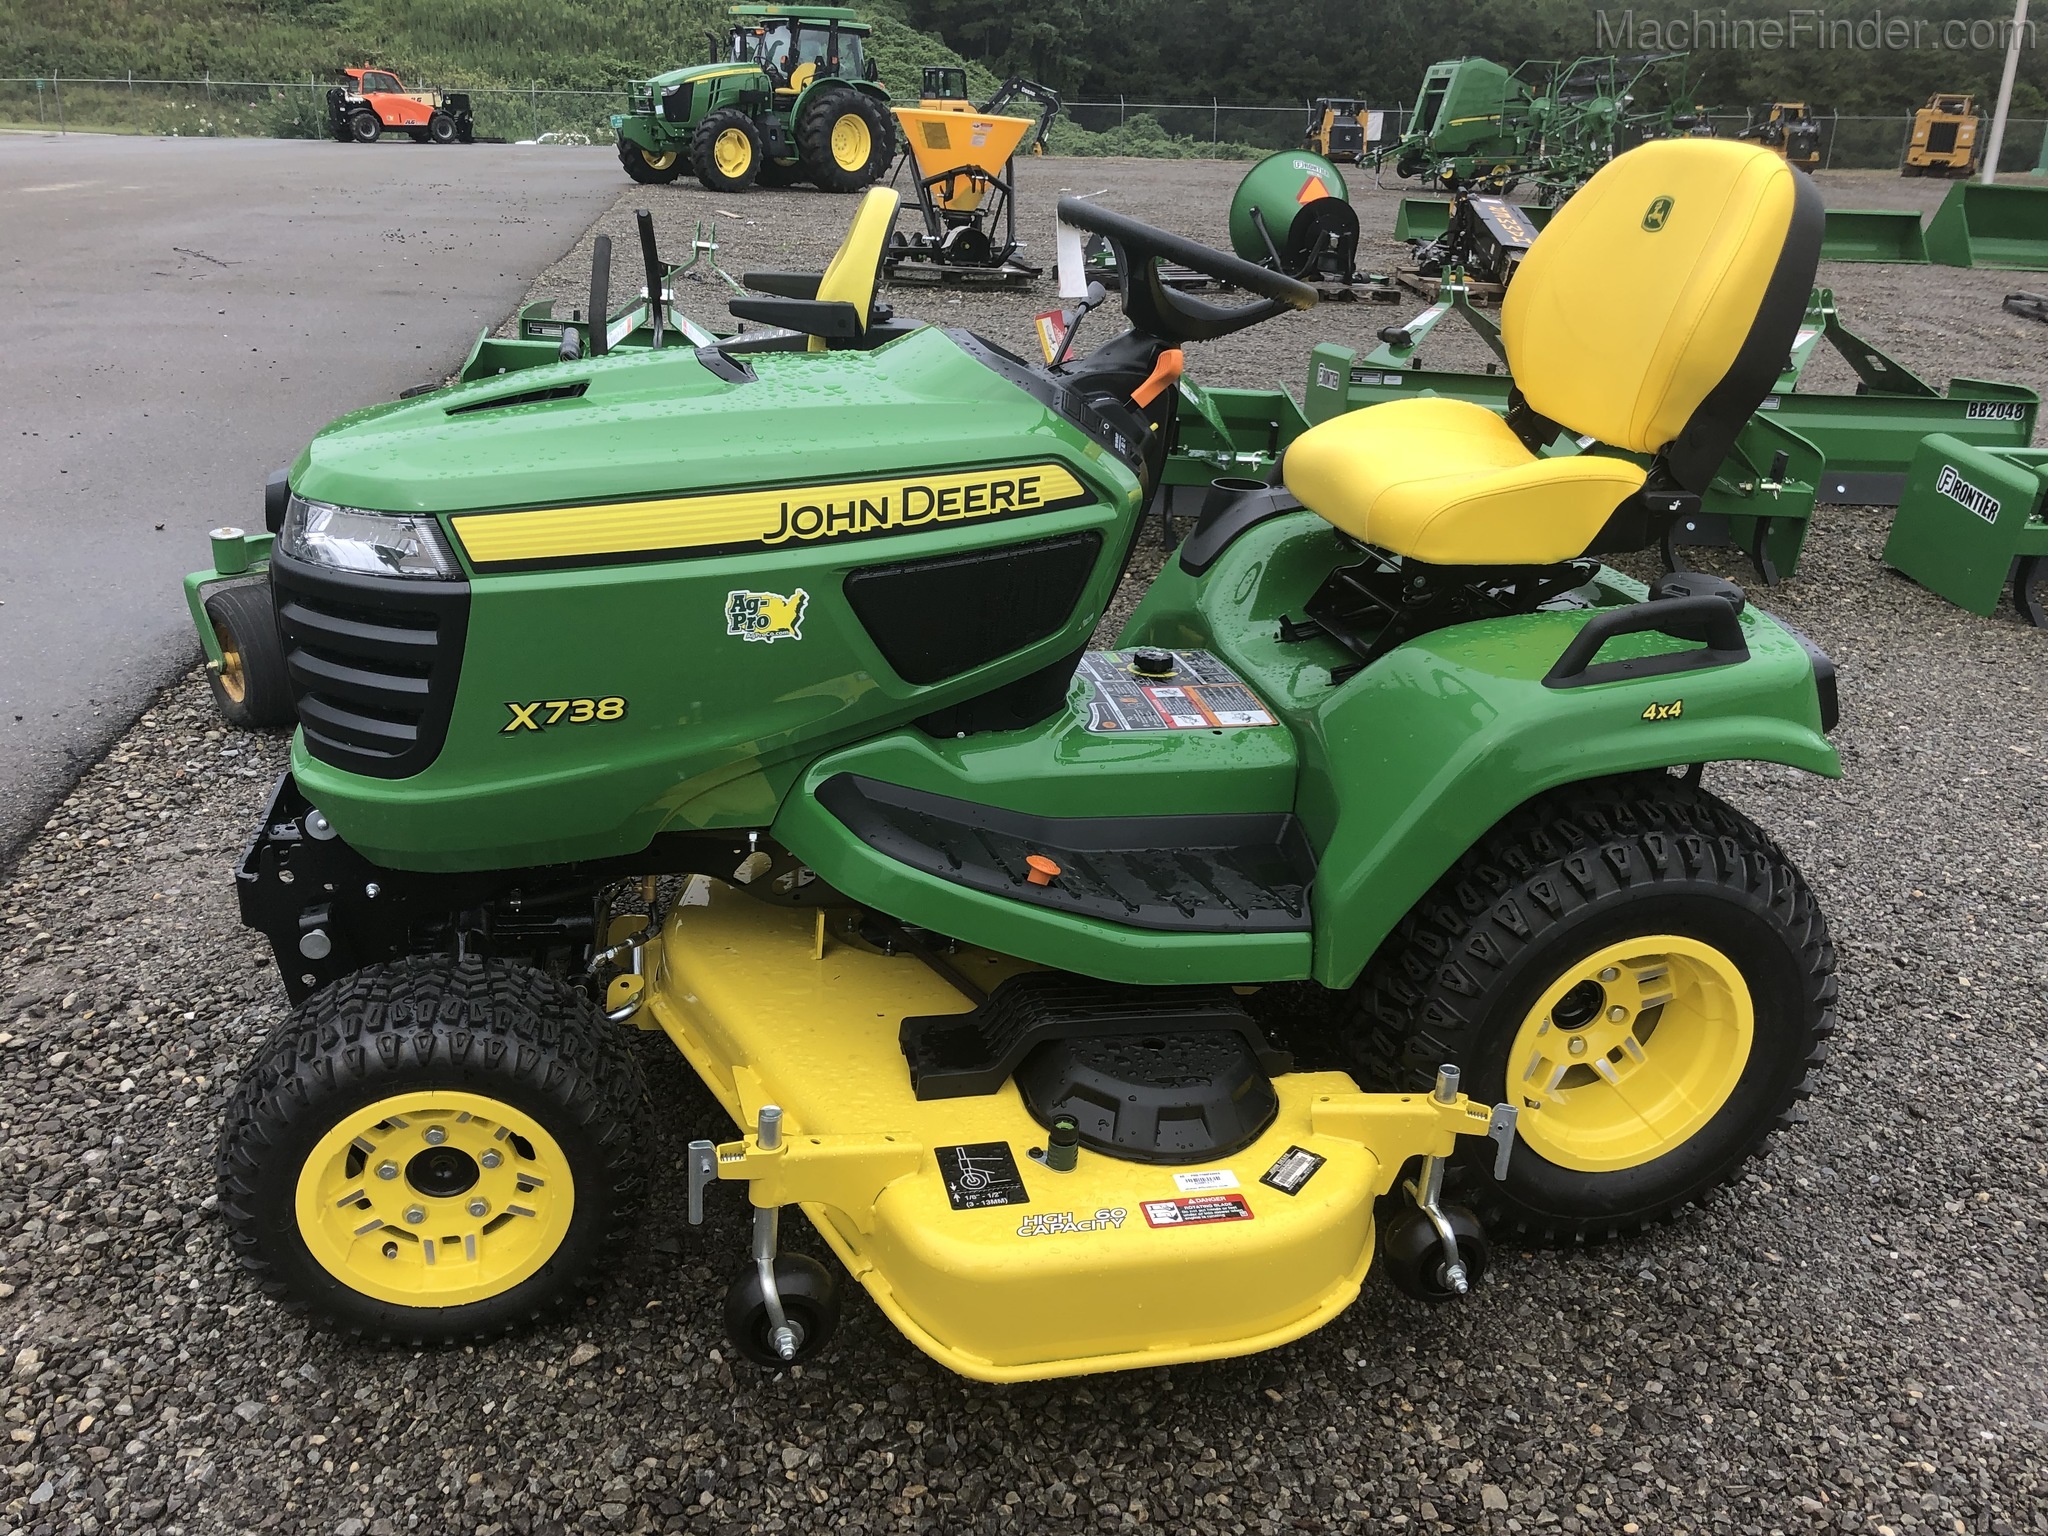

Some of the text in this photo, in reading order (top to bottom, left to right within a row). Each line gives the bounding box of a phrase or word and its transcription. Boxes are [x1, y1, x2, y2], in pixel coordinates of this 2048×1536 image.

[1967, 402, 2024, 419] BB2048
[1937, 465, 2000, 523] FRONTIER
[763, 475, 1042, 540] JOHN DEERE
[730, 594, 768, 615] Ag-
[731, 612, 770, 631] Pro
[502, 697, 626, 732] X738
[1642, 700, 1682, 720] 4x4
[981, 1197, 1008, 1206] 13MM)
[1016, 1217, 1126, 1238] CAPACITY
[1023, 1208, 1127, 1227] HIGH 60
